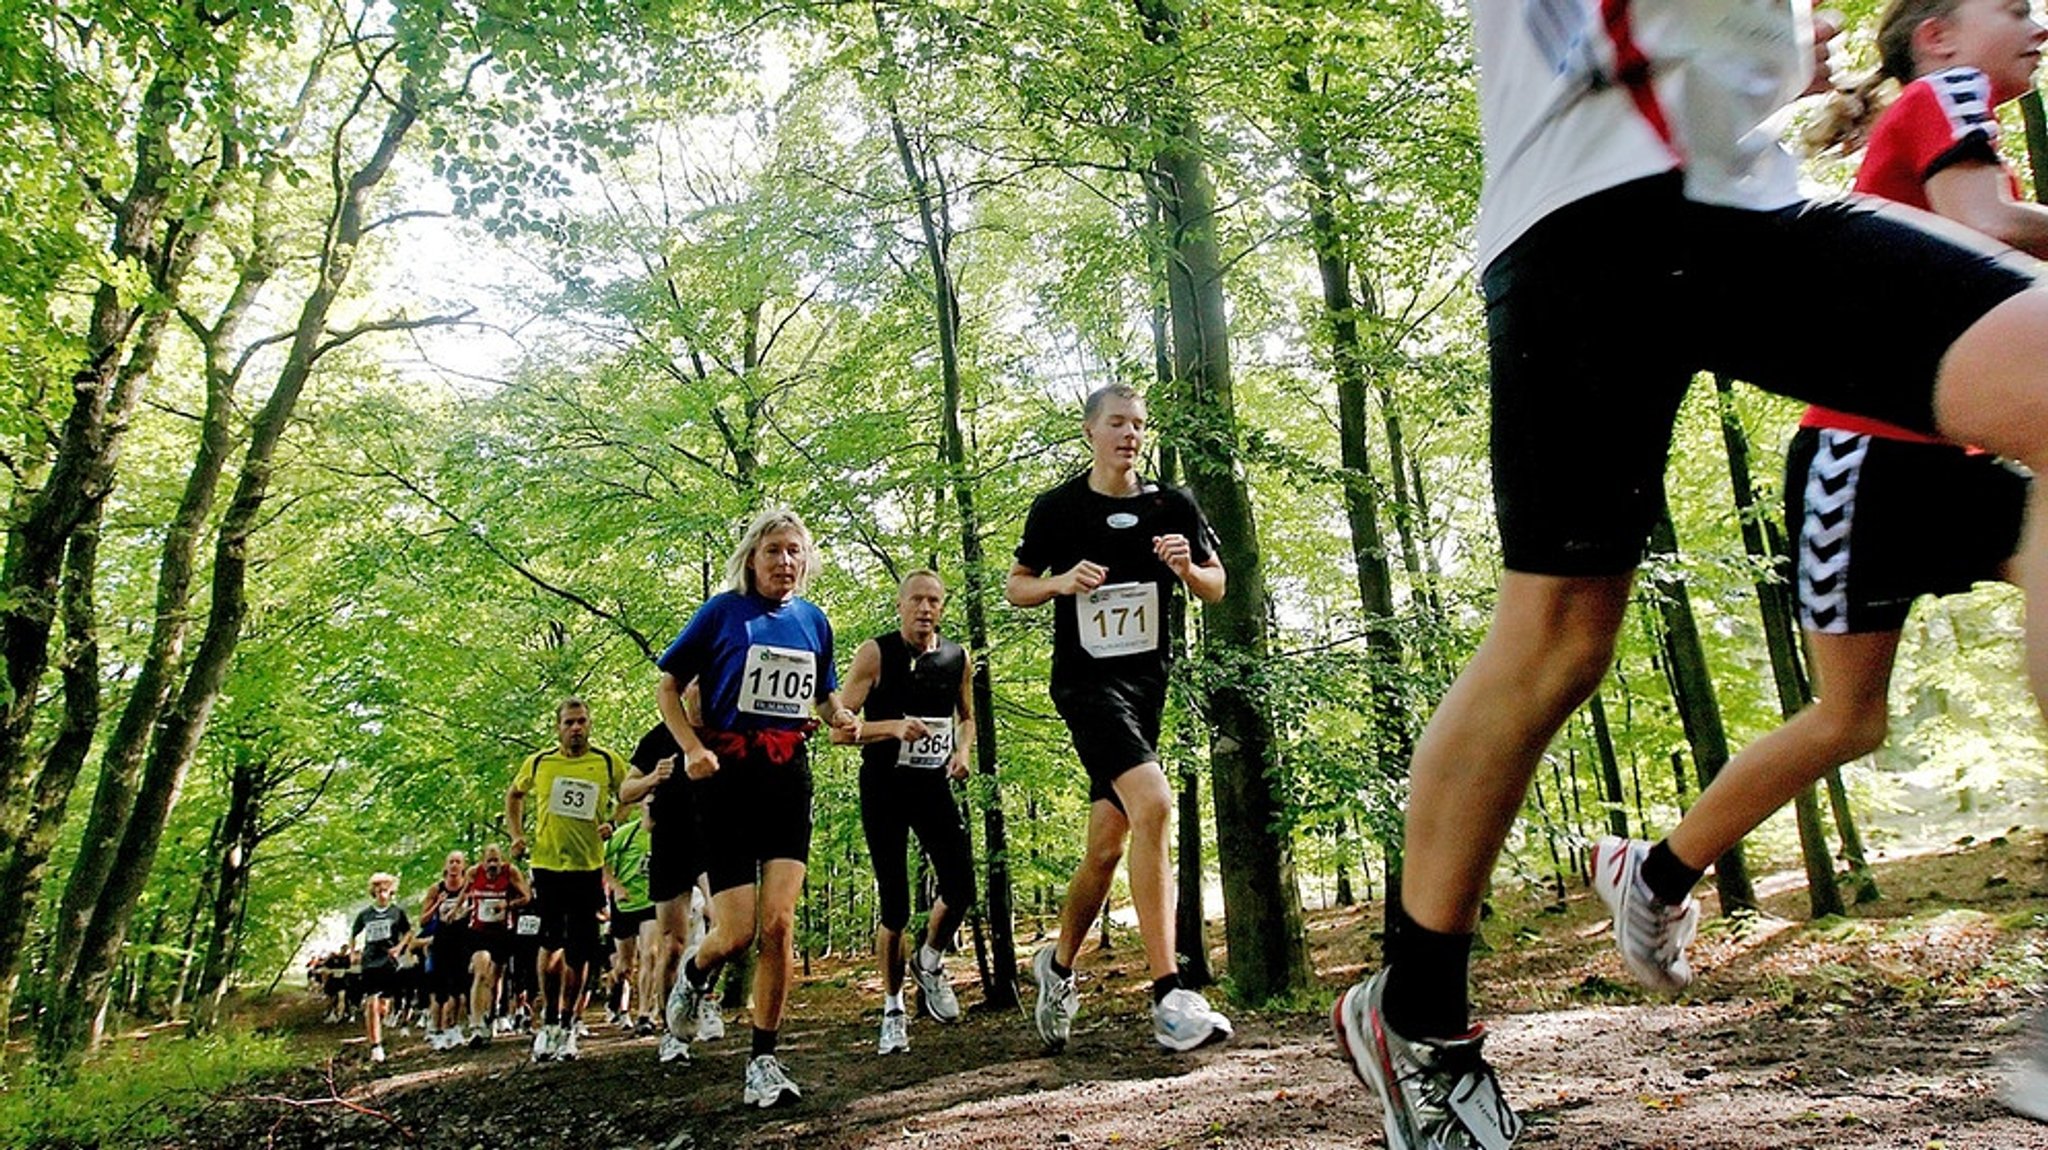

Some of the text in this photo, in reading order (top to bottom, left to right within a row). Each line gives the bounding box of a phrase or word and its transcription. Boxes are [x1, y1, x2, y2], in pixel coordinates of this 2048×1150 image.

[1093, 605, 1145, 638] 171
[749, 667, 813, 700] 1105
[562, 790, 584, 807] 53
